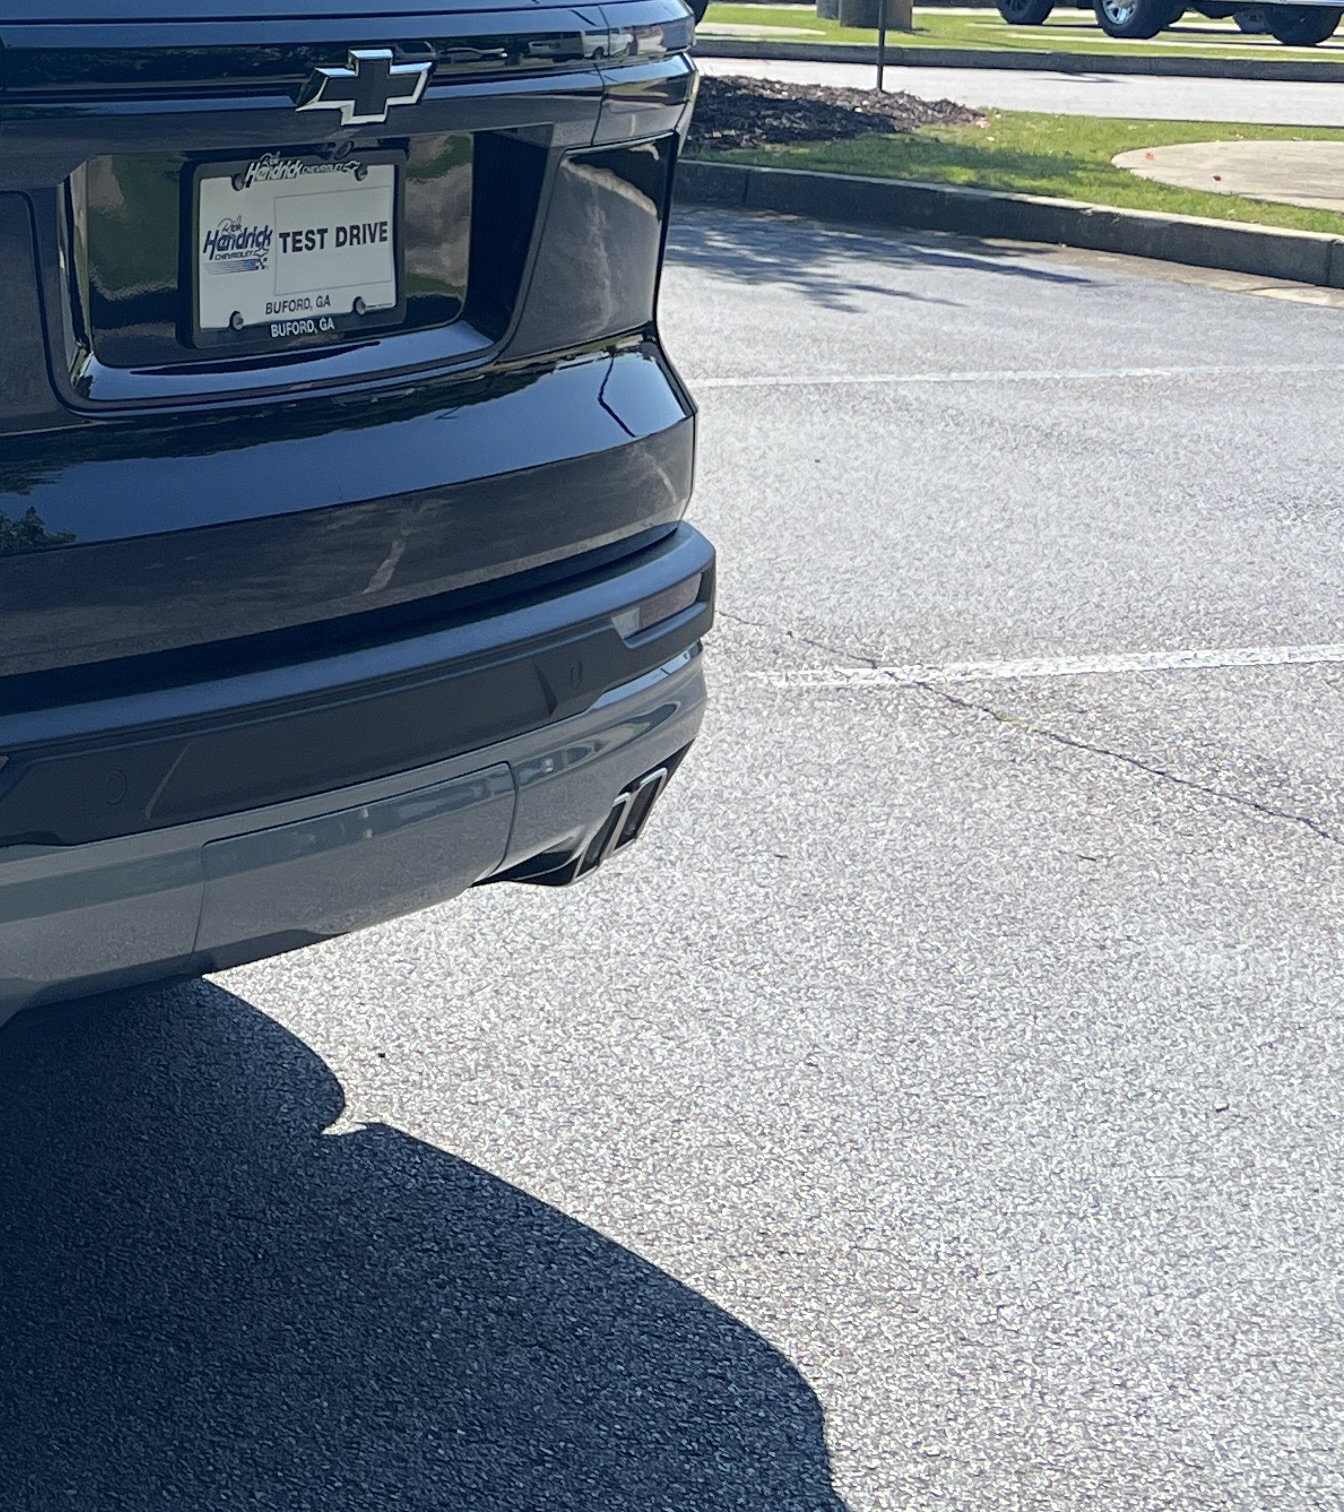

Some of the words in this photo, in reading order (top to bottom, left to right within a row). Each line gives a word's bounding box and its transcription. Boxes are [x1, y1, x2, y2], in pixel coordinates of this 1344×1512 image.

[244, 160, 303, 186] Hendrick
[202, 225, 273, 261] Hendrick
[278, 227, 329, 254] TEST
[335, 220, 389, 248] DRIVE
[265, 297, 313, 315] BUFORD,
[315, 294, 331, 308] GA
[270, 320, 318, 337] BUFORD,
[319, 317, 335, 331] GA
